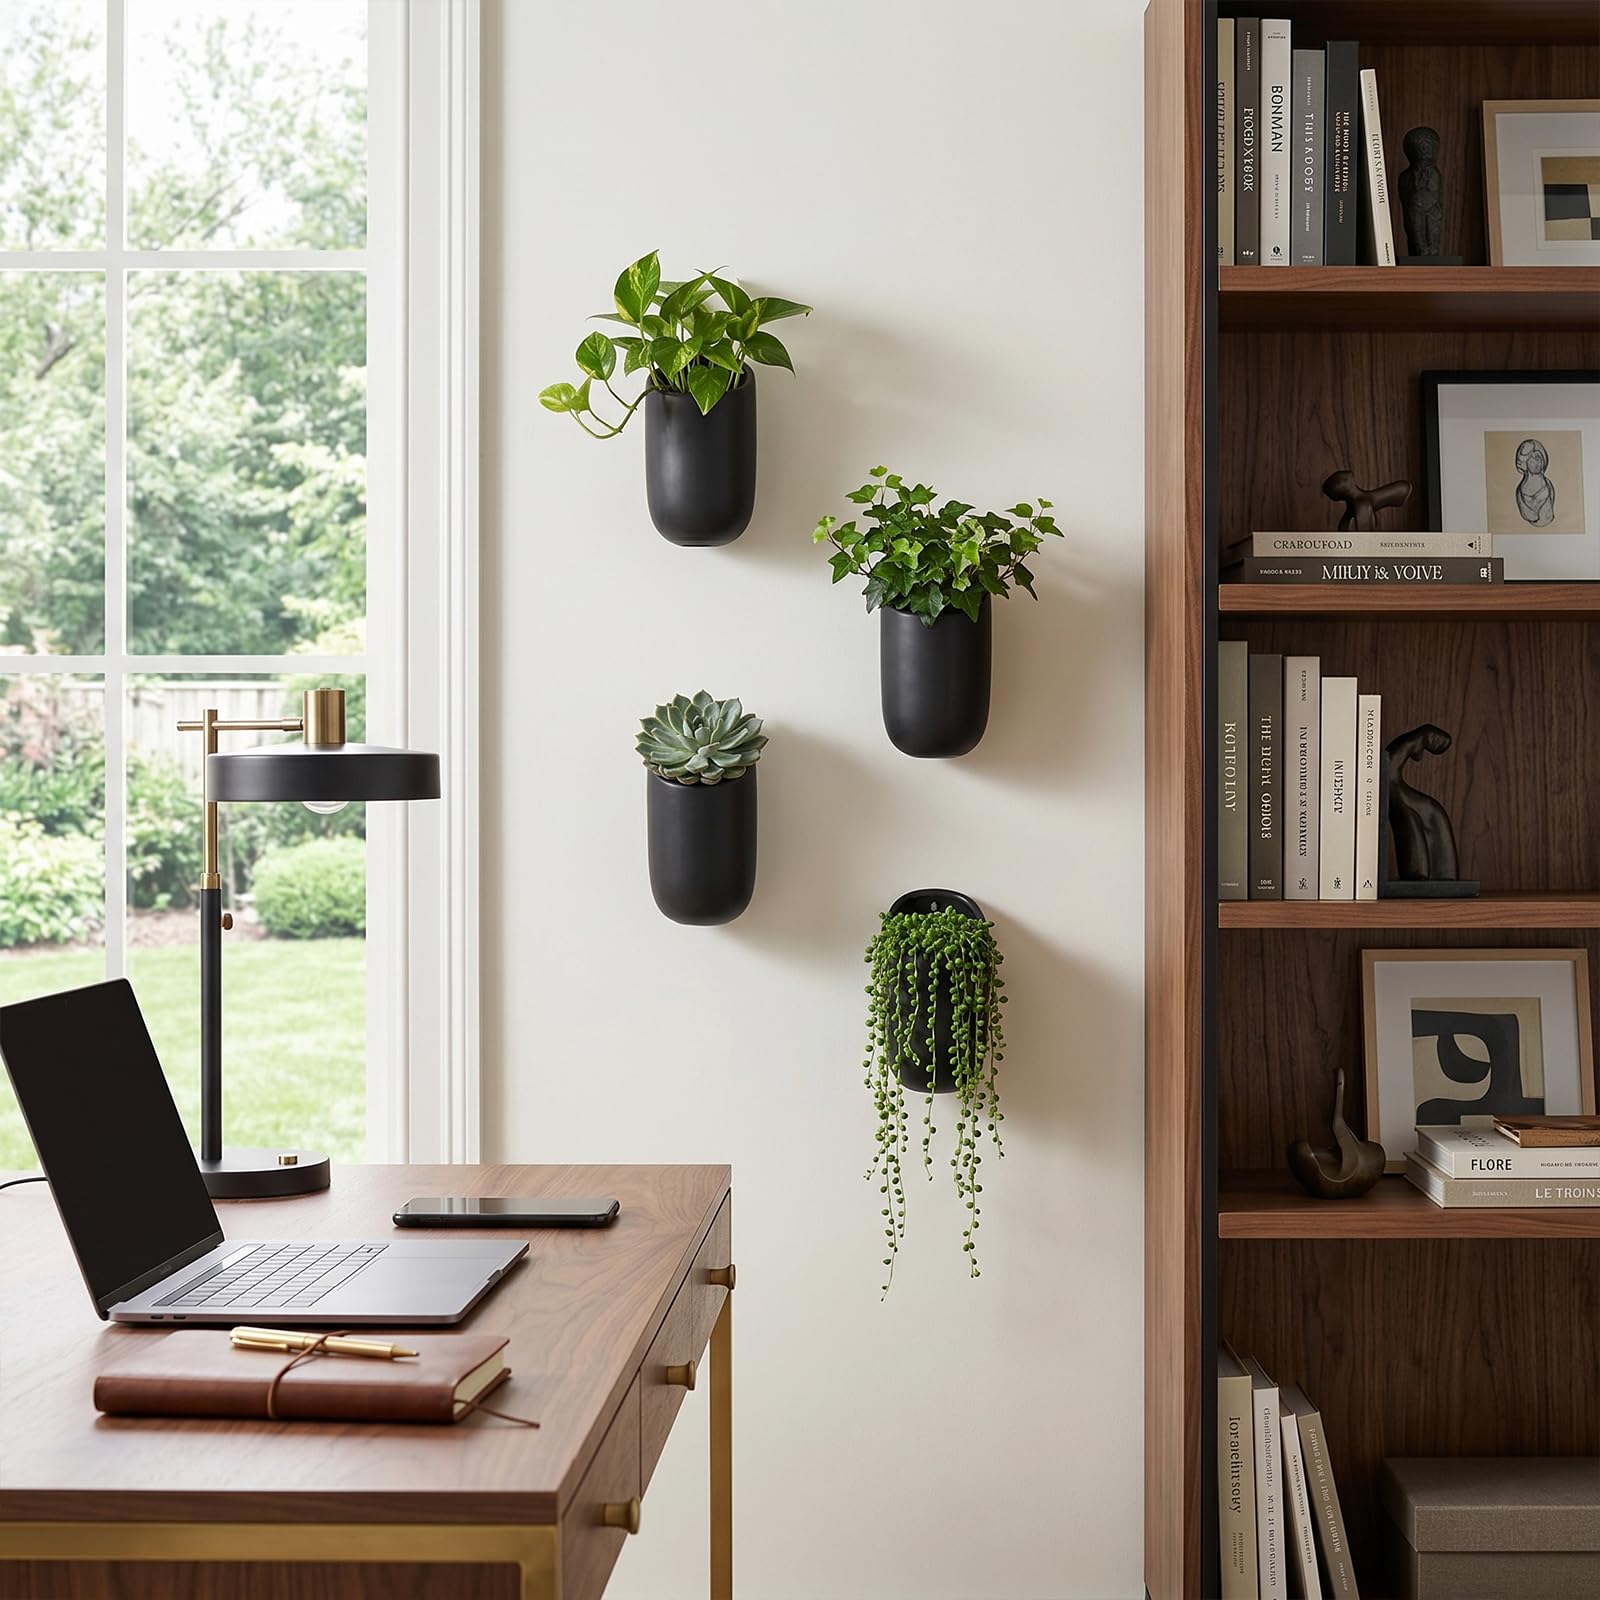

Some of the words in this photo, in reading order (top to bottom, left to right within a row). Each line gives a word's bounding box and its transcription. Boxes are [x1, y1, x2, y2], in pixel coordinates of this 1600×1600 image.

[1271, 85, 1283, 153] BONMAN
[1393, 565, 1443, 580] VOIVE
[1471, 1158, 1512, 1171] FLORE
[1535, 1187, 1552, 1199] LE
